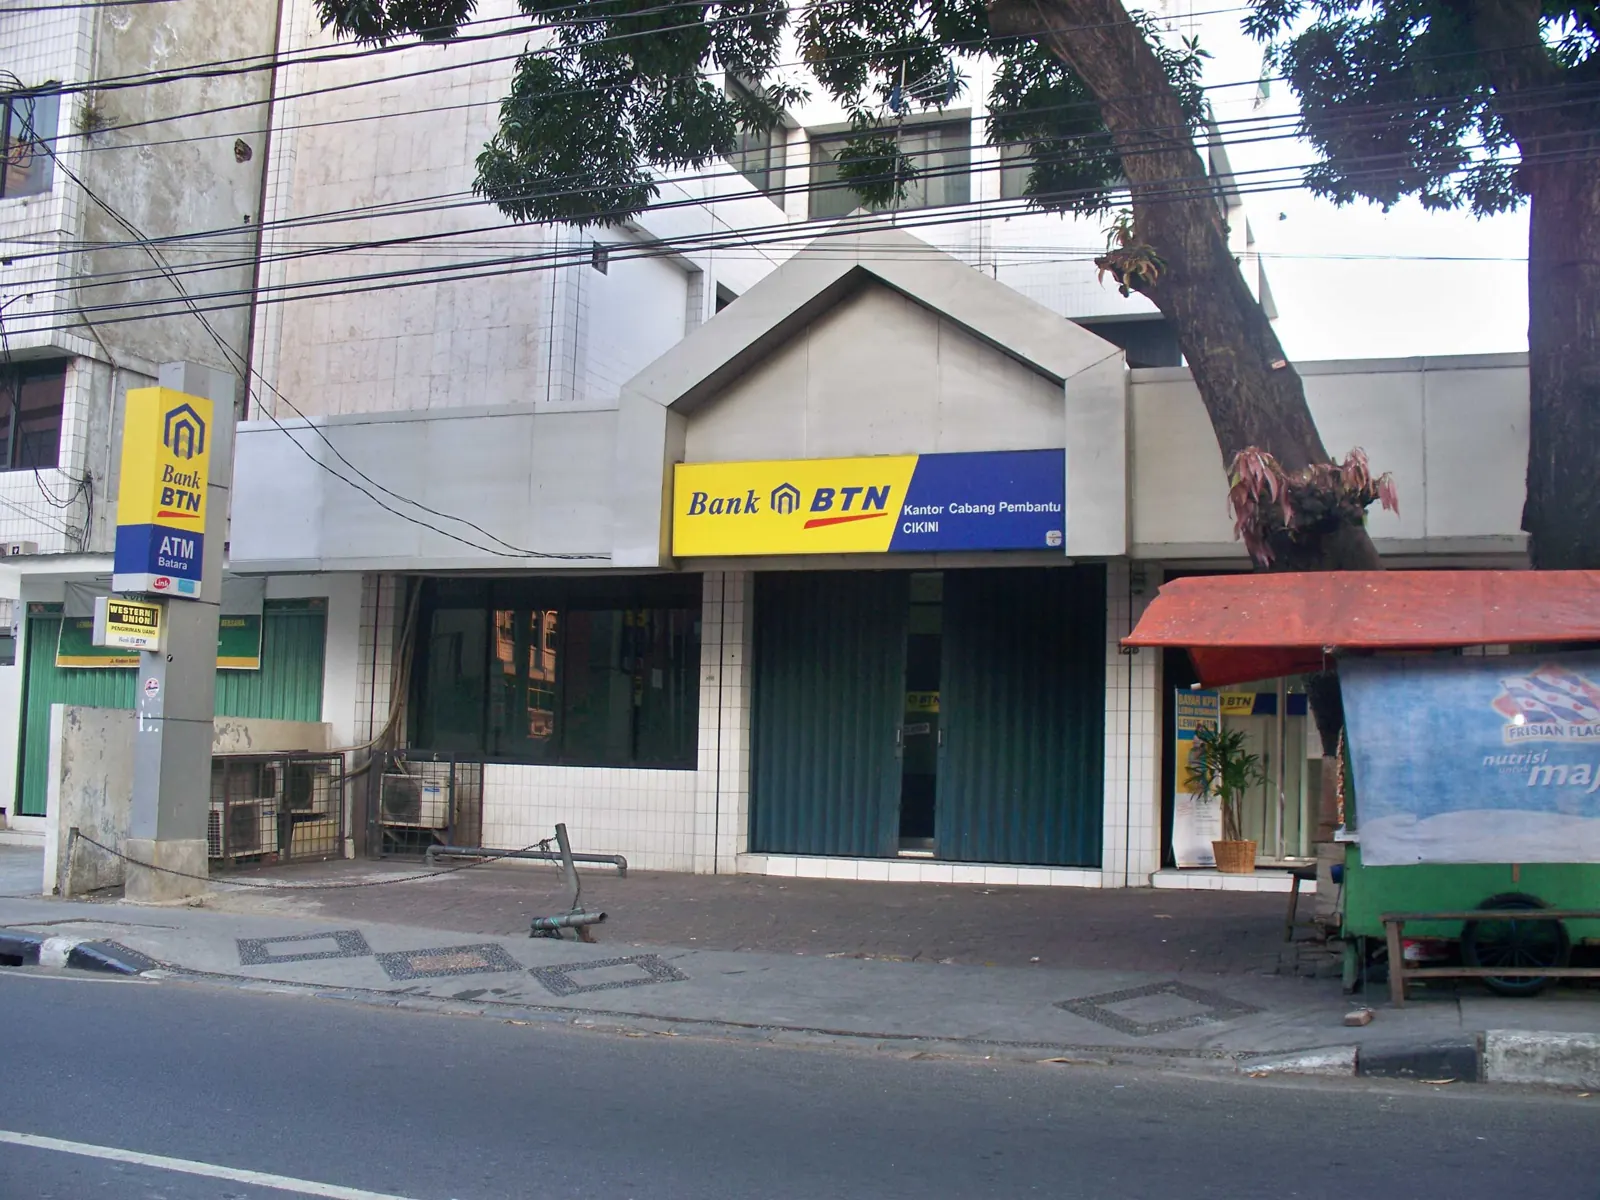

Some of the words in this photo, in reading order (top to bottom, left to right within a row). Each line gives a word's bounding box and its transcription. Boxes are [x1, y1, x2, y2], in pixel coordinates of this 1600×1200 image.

[162, 464, 201, 490] Bank
[160, 487, 201, 512] BTN
[687, 490, 761, 516] Bank
[809, 485, 891, 512] BTN
[904, 505, 944, 515] Kantor
[949, 502, 995, 515] Cabang
[999, 502, 1061, 512] Pembantu
[903, 522, 938, 533] CIKINI
[159, 536, 194, 560] ATM
[158, 557, 187, 571] Batara
[110, 606, 151, 617] WESTERN
[122, 615, 151, 625] UNION
[1227, 696, 1252, 706] BTN
[1509, 725, 1564, 738] FRISIAN
[1569, 725, 1600, 737] FLAG
[1483, 749, 1548, 766] nutrisi
